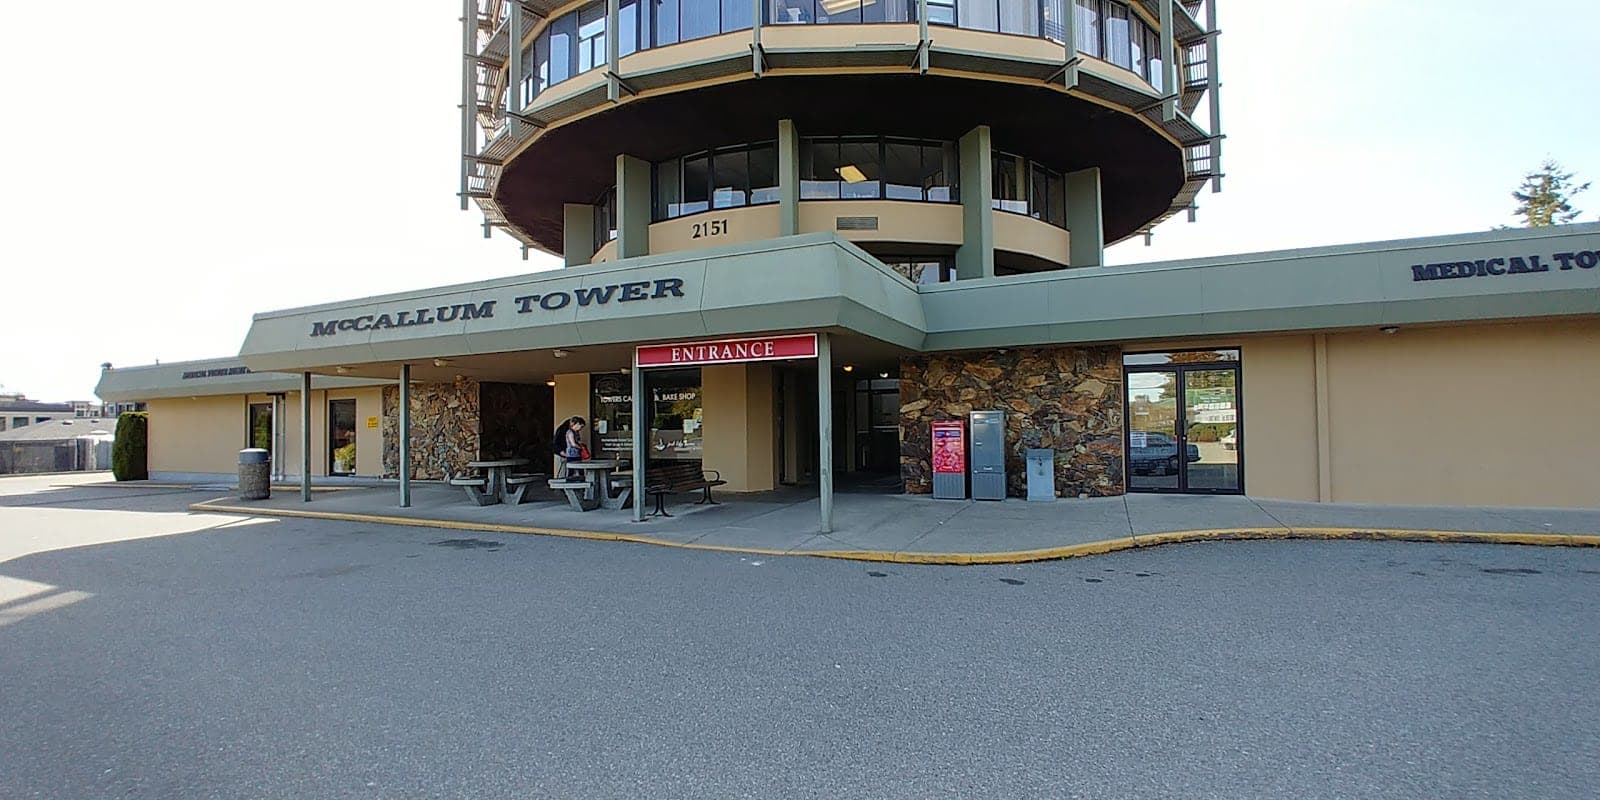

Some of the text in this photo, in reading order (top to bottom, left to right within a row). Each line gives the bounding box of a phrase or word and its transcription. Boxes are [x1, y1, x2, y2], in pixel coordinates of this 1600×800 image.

[692, 219, 728, 239] 2151
[1411, 250, 1600, 282] MEDICAL TO
[310, 278, 685, 337] McCALLUM TOWER
[671, 341, 775, 362] ENTRANCE
[662, 393, 678, 402] BAKE
[679, 391, 696, 401] SHOP
